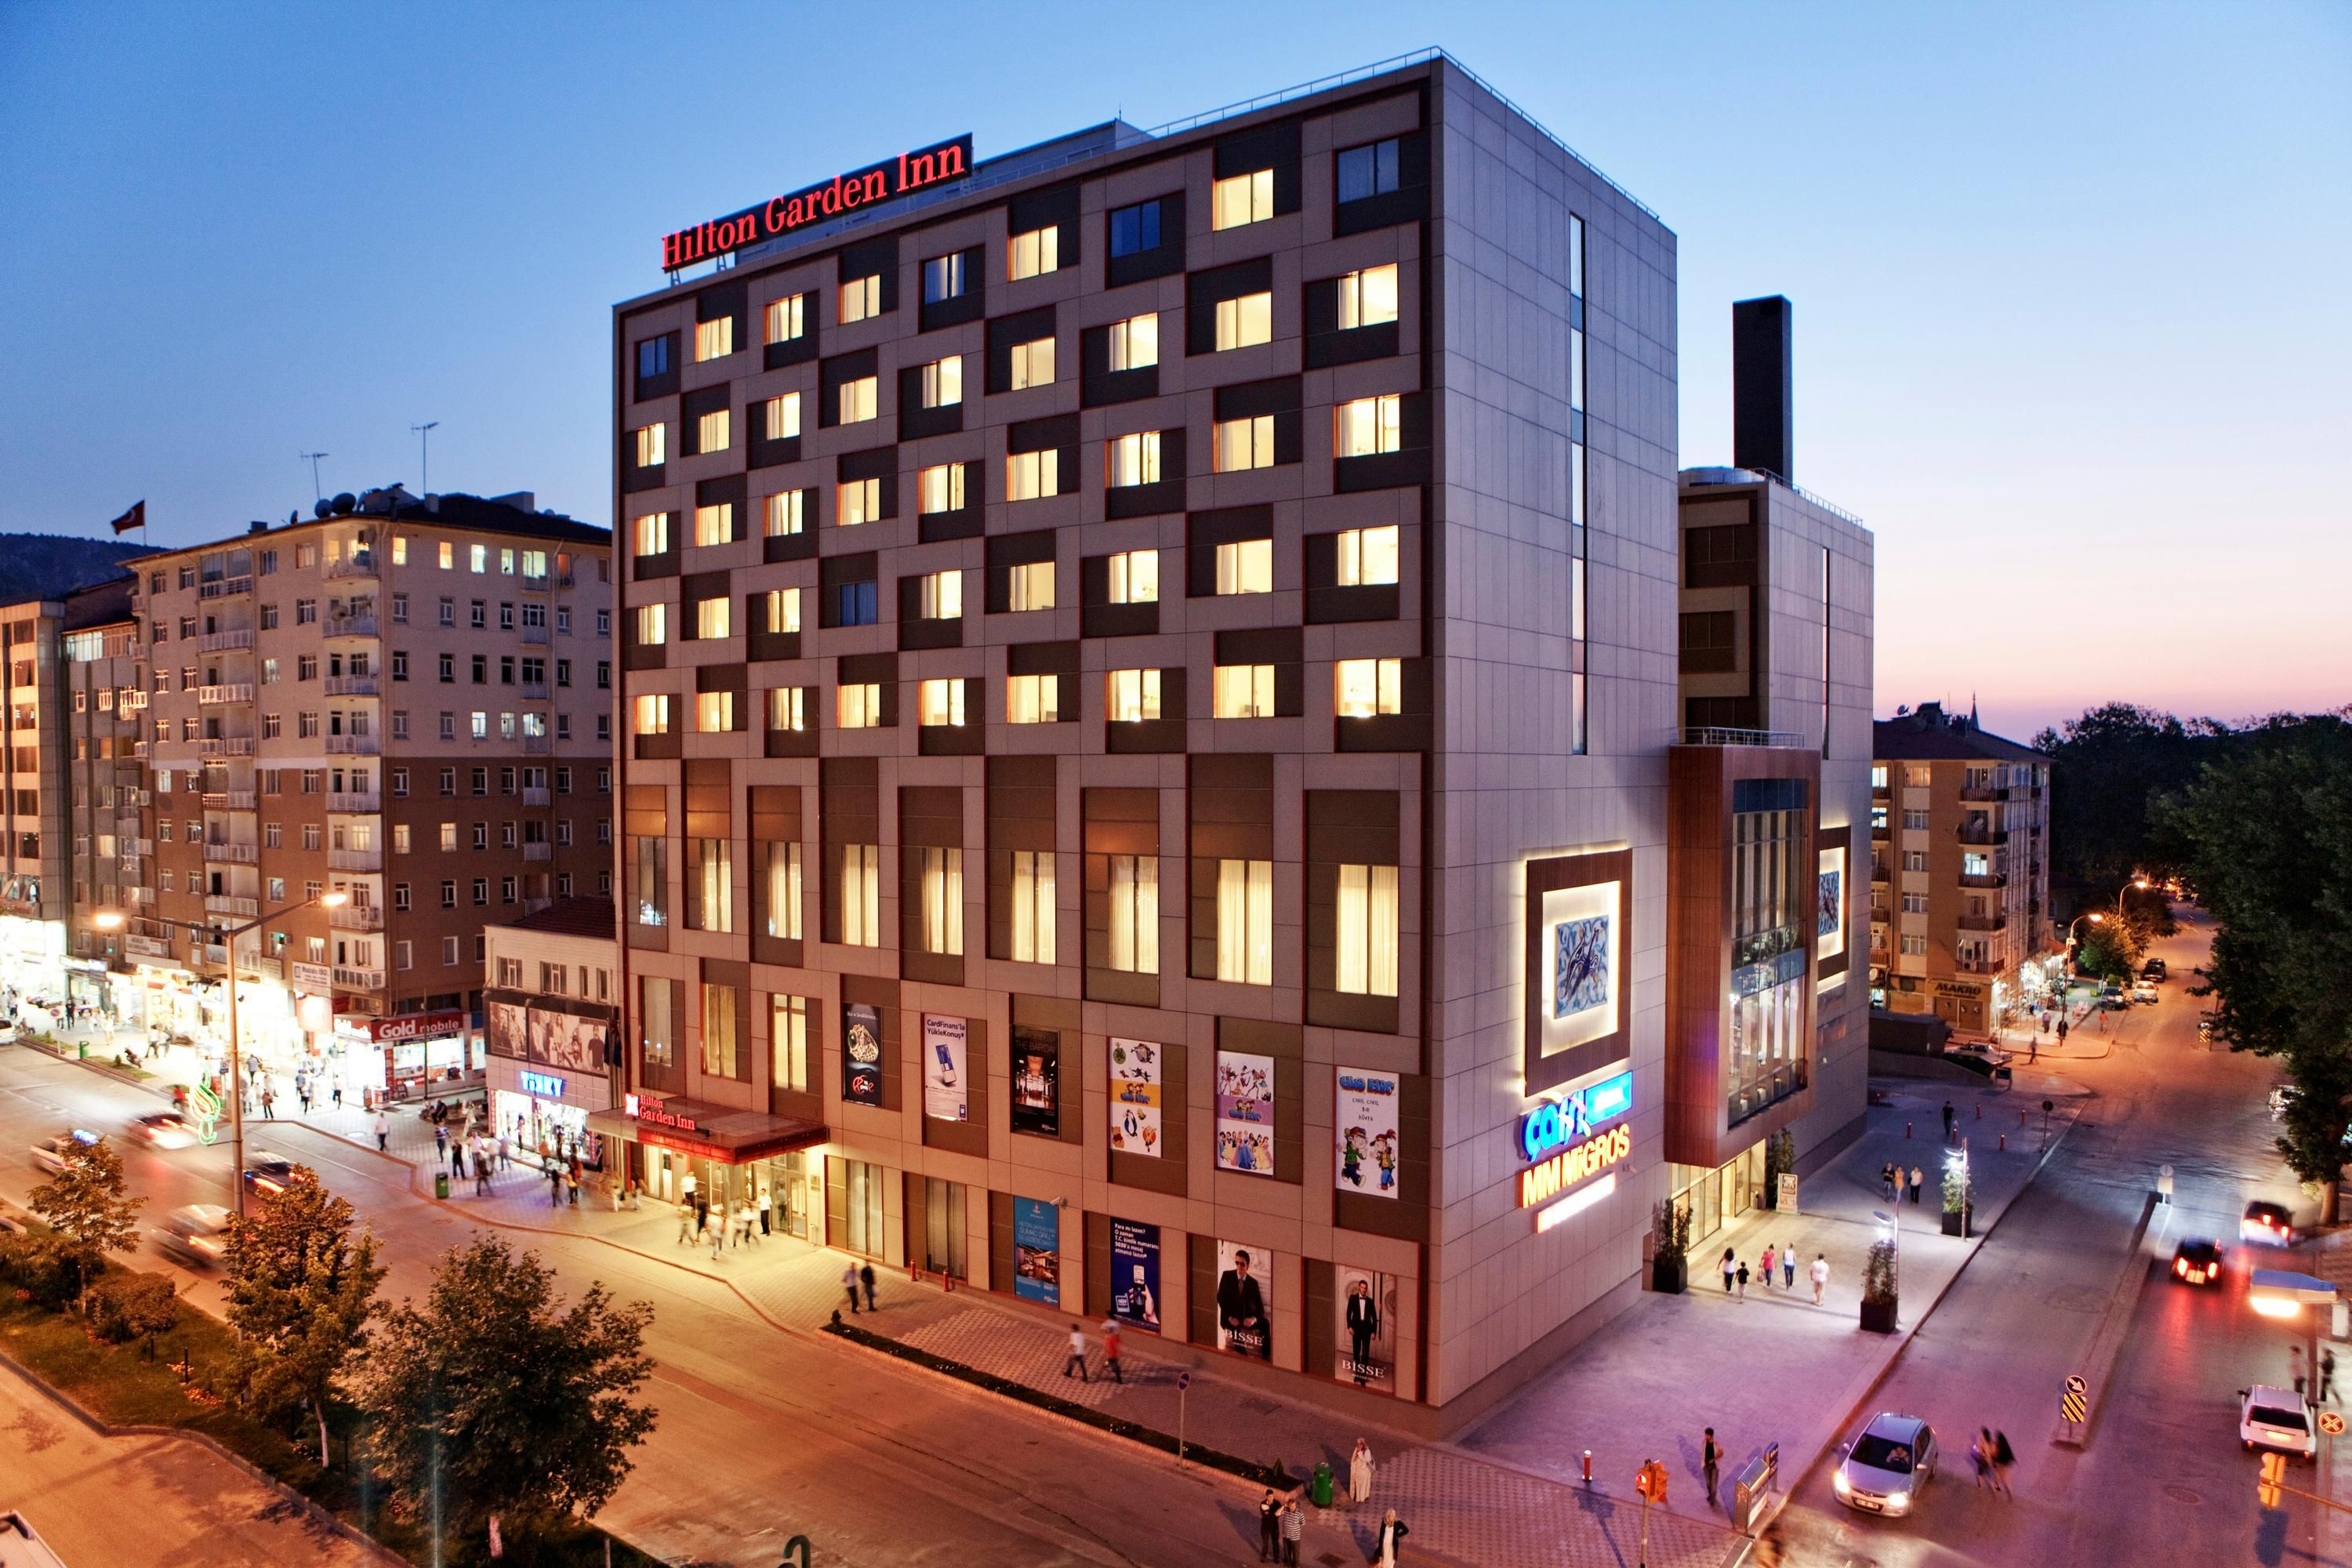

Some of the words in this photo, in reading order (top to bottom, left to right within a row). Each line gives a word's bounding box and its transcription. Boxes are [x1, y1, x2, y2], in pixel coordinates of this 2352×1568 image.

[662, 219, 757, 269] Hilton
[764, 175, 887, 234] Garden
[896, 144, 965, 193] Inn
[1934, 982, 1982, 996] MAKRO
[379, 1020, 416, 1038] Gold
[419, 1020, 459, 1033] mobile
[927, 1019, 966, 1031] CardFinans'la
[640, 1094, 663, 1108] Hilton
[640, 1106, 675, 1126] Garden
[677, 1114, 695, 1130] Inn
[1131, 1244, 1144, 1253] mesaj
[1225, 1328, 1264, 1346] BİSSE
[1341, 1359, 1385, 1378] BİSSE
